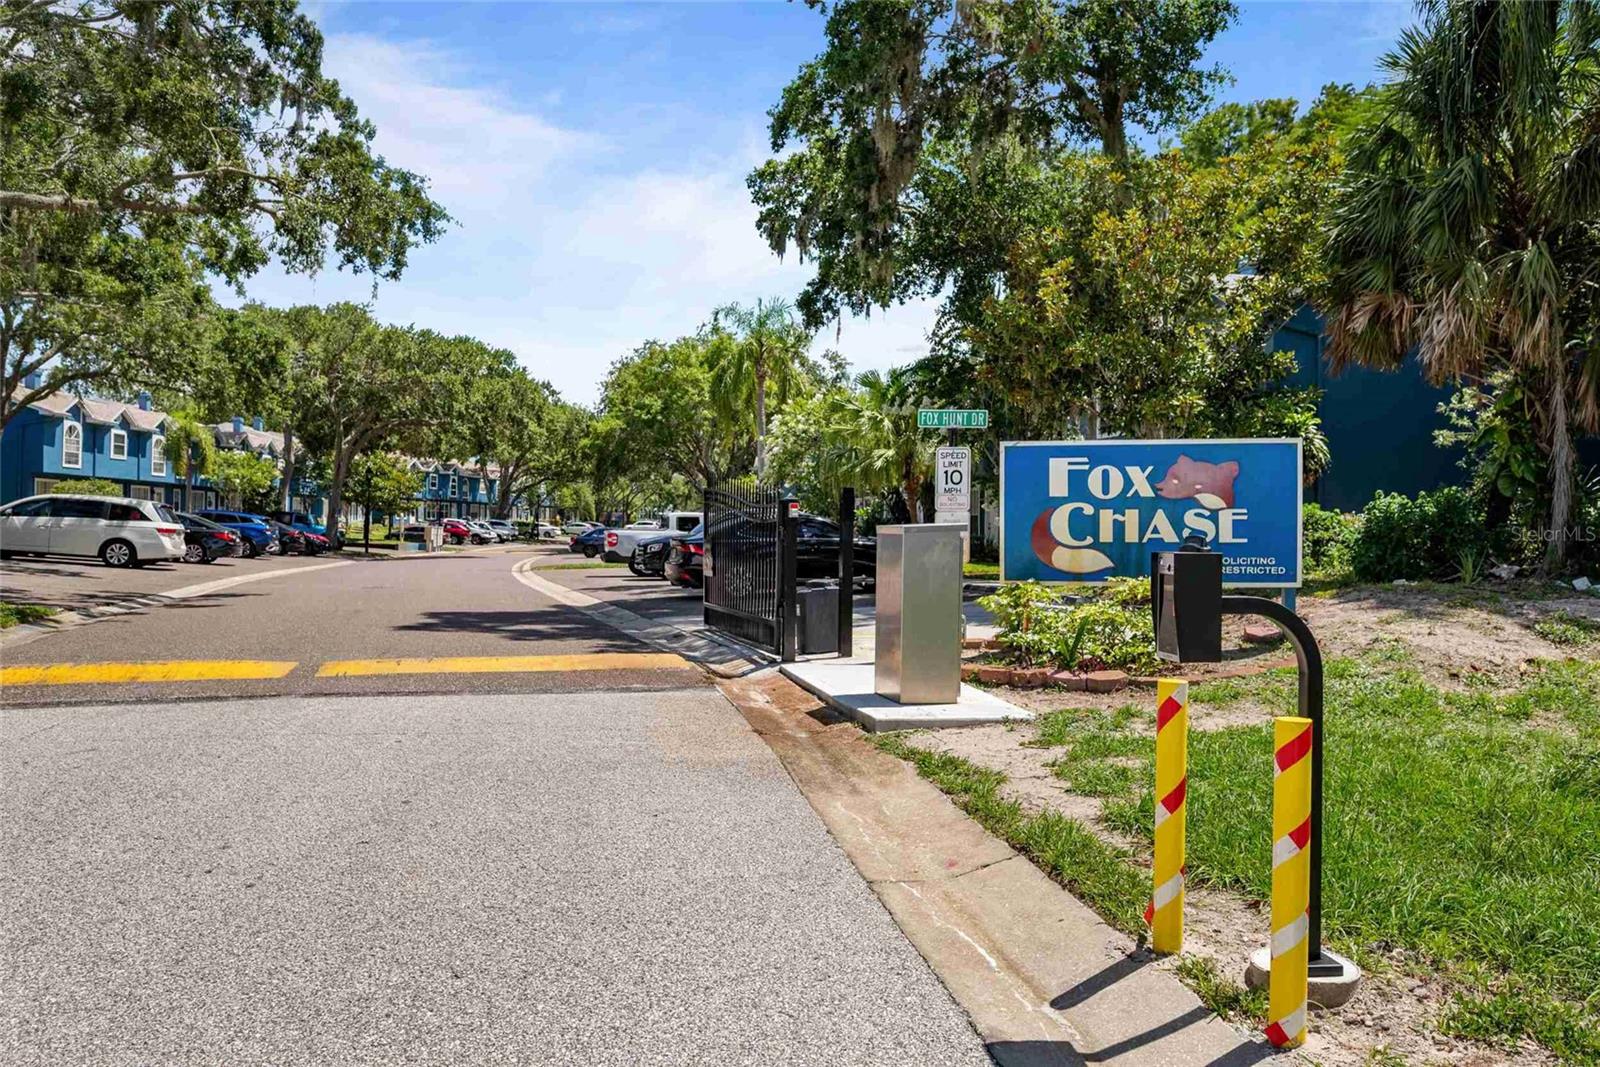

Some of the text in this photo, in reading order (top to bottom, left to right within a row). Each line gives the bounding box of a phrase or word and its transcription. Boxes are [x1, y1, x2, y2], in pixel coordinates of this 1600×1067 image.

[921, 412, 985, 426] FOX HUNT DR
[940, 452, 967, 460] SPEED
[943, 469, 963, 486] 10
[1221, 557, 1276, 565] OLICITING
